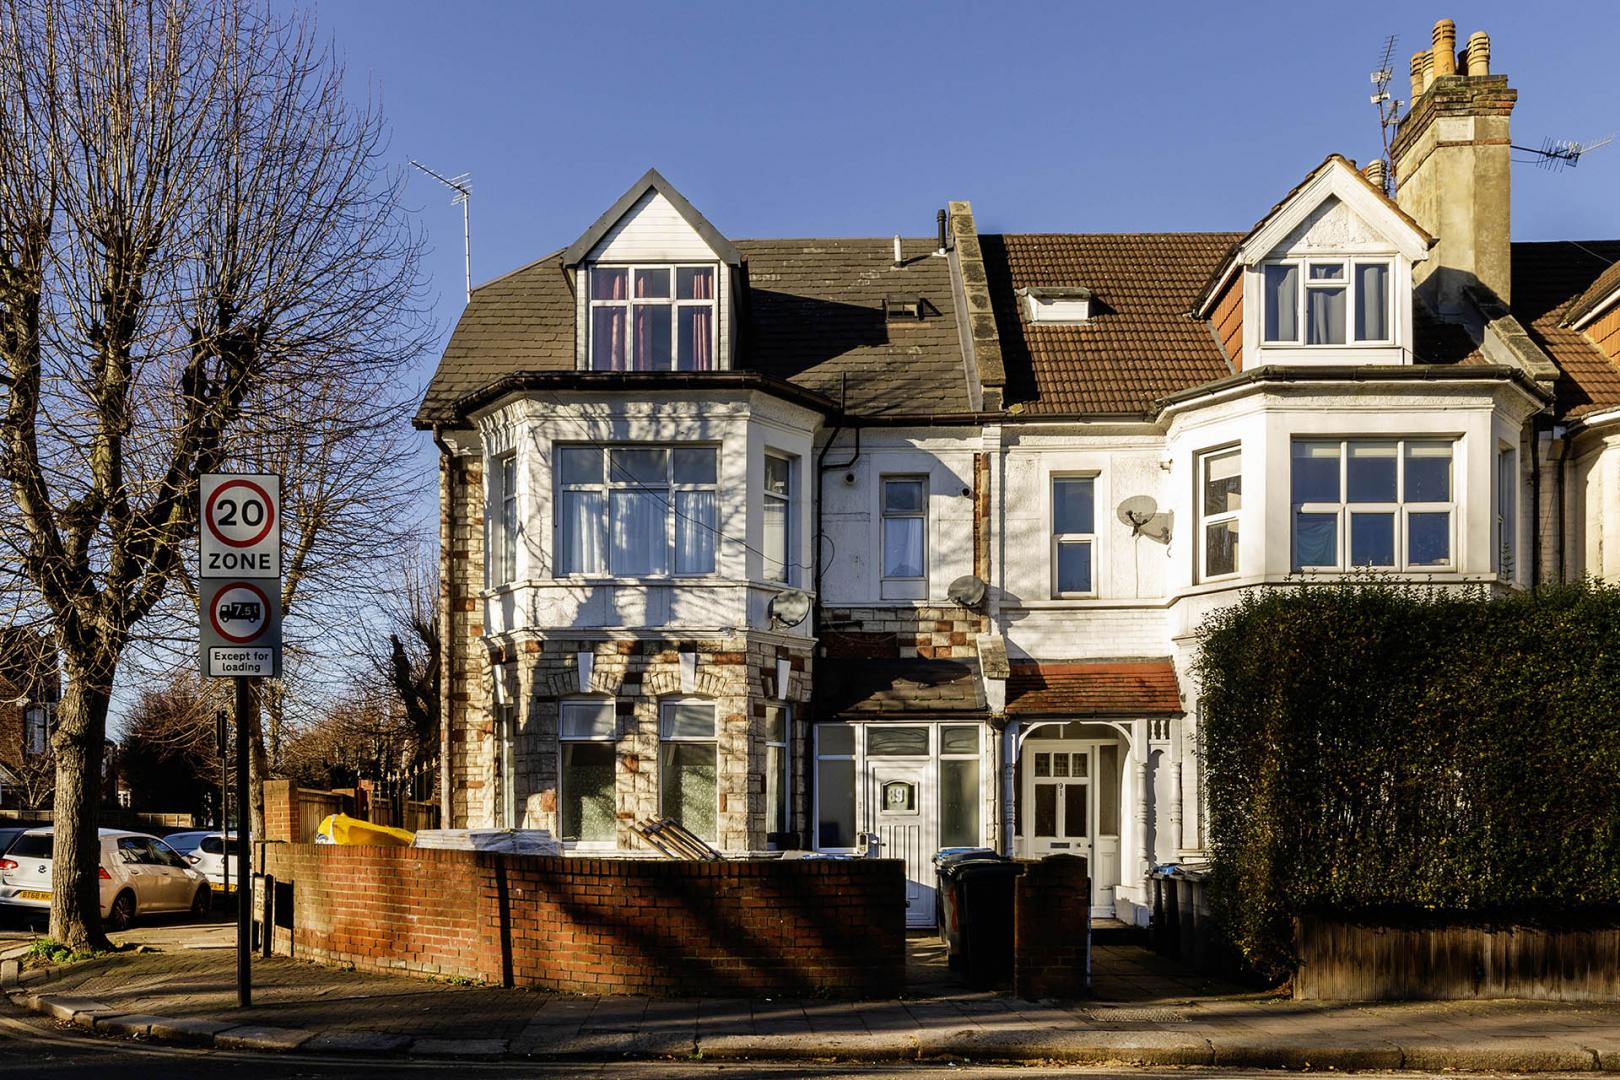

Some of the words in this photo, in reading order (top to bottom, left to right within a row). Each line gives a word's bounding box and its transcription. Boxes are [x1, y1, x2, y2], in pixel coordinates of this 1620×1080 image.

[217, 499, 264, 527] 20
[209, 553, 271, 570] ZONE
[214, 651, 250, 663] Except
[254, 651, 269, 661] for
[223, 662, 261, 673] loading
